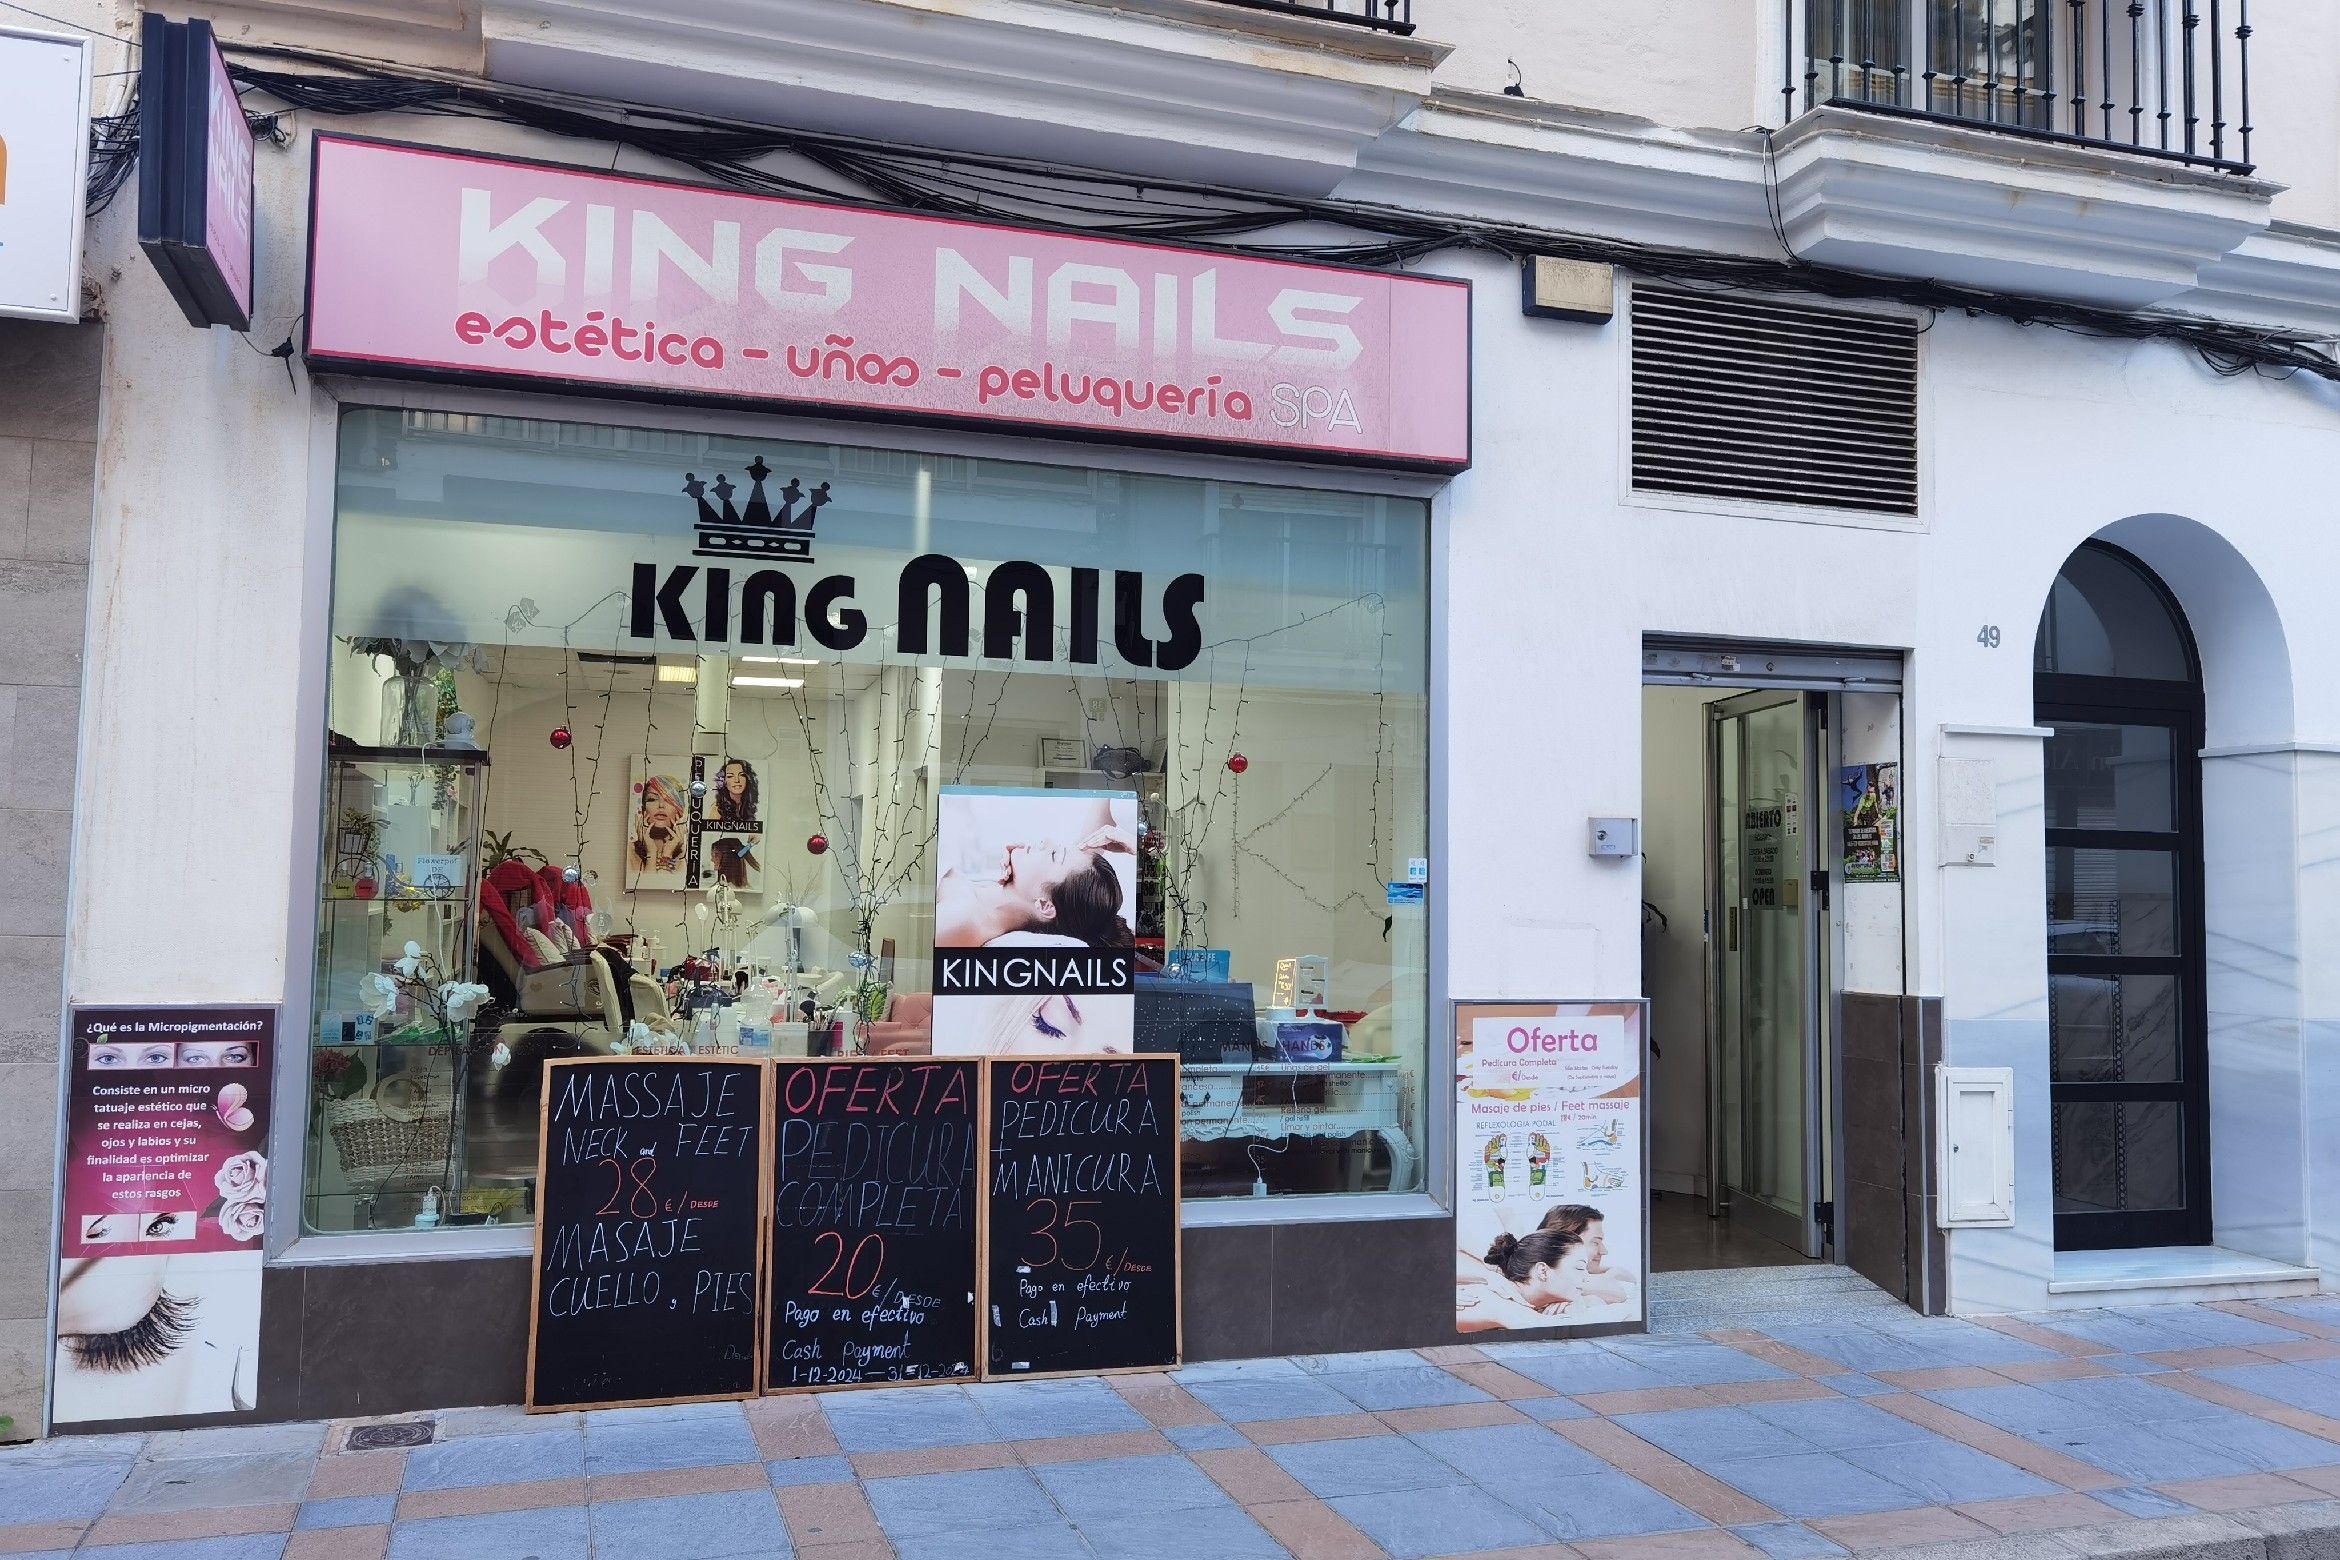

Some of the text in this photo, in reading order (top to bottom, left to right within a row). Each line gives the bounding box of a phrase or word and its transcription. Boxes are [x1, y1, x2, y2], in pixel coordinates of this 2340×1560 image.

[209, 64, 250, 190] KING
[458, 187, 1364, 370] KING NAILS
[454, 309, 724, 370] estética
[786, 334, 920, 387] uñas
[977, 361, 1252, 421] peluquería
[1270, 381, 1363, 434] SPA
[631, 554, 1204, 671] KING NAILS
[1977, 625, 2000, 648] 49
[706, 820, 759, 831] KINGNAILS
[1752, 888, 1774, 906] OPEN
[942, 958, 1127, 988] KINGNAILS
[87, 1020, 263, 1034] ¿Qué es la Micropigmentación?
[1507, 1026, 1598, 1053] Oferta
[1482, 1058, 1557, 1067] Pedicura Completa
[93, 1084, 211, 1096] Consiste en un micro
[785, 1066, 968, 1116] OFERTA
[1011, 1062, 1149, 1097] OFERTA
[94, 1102, 207, 1114] tatuaje estético que
[555, 1071, 742, 1122] MASSAJE
[1472, 1103, 1510, 1114] Masaje
[1513, 1102, 1526, 1112] de
[1530, 1102, 1551, 1113] pies
[1561, 1101, 1585, 1111] Feet
[1588, 1100, 1630, 1111] massaje
[97, 1119, 202, 1130] se realiza en cejas,
[1001, 1099, 1159, 1139] PEDICURA
[101, 1136, 196, 1149] ojos y labios y su
[563, 1122, 753, 1166] NECK and FEET
[781, 1118, 975, 1186] PEDICURA
[87, 1153, 209, 1165] finalidad es optimizar
[102, 1170, 192, 1183] la apariencia de
[595, 1157, 658, 1219] 28
[992, 1153, 1162, 1200] MANICURA
[112, 1189, 182, 1200] estos rasgos
[776, 1180, 963, 1229] COMPLETA
[546, 1217, 703, 1271] MASAJE
[1020, 1198, 1103, 1271] 35
[807, 1232, 884, 1299] 20
[549, 1271, 661, 1317] CUELLO
[692, 1269, 753, 1316] PIES
[1020, 1274, 1132, 1299] Pago en efectivo
[785, 1300, 925, 1332] Pago en efectivo
[1020, 1300, 1128, 1331] Cash Payment
[782, 1338, 822, 1360] Cash
[791, 1365, 863, 1383] 1-12-2024
